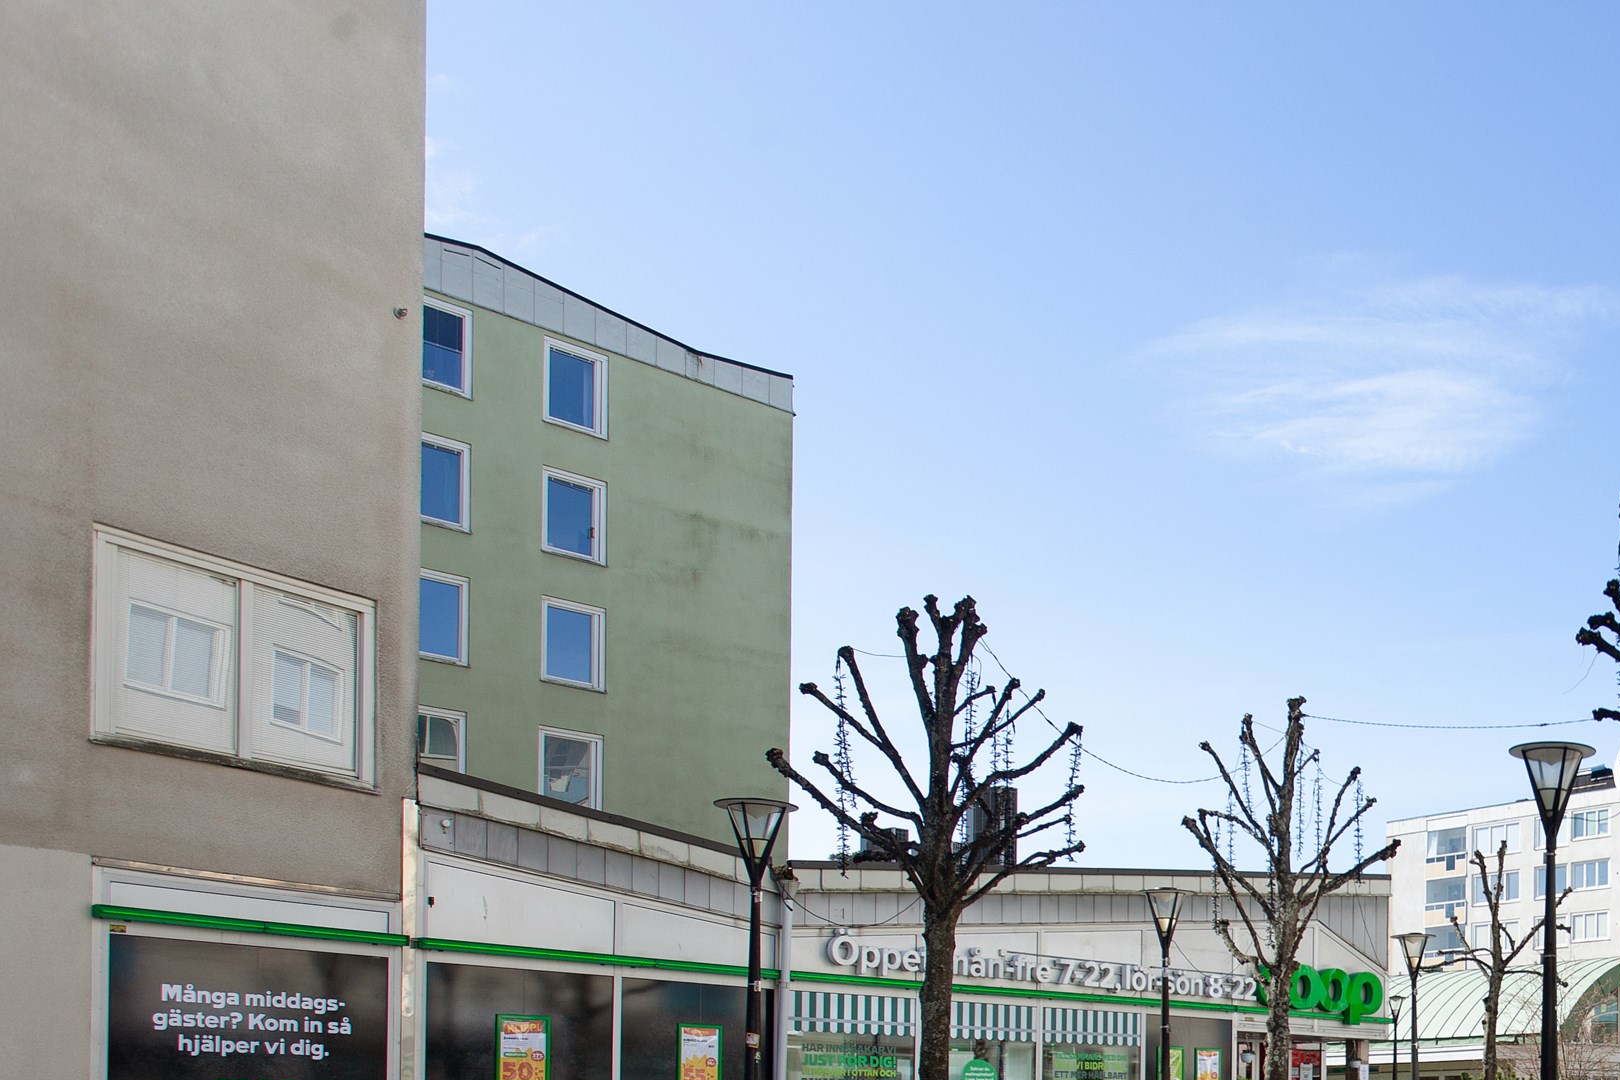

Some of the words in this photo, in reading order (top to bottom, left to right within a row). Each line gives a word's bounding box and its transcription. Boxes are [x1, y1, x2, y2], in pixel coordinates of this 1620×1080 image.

[160, 983, 240, 1009] Många
[245, 990, 346, 1015] middags-
[1205, 974, 1258, 1001] 8-22
[152, 1009, 243, 1031] gäster?
[248, 1013, 299, 1033] Kom
[304, 1016, 322, 1034] in
[327, 1016, 352, 1035] så
[178, 1034, 260, 1056] hjälper
[264, 1038, 286, 1055] vi
[290, 1039, 330, 1061] dig.
[1054, 1070, 1070, 1079] ETT
